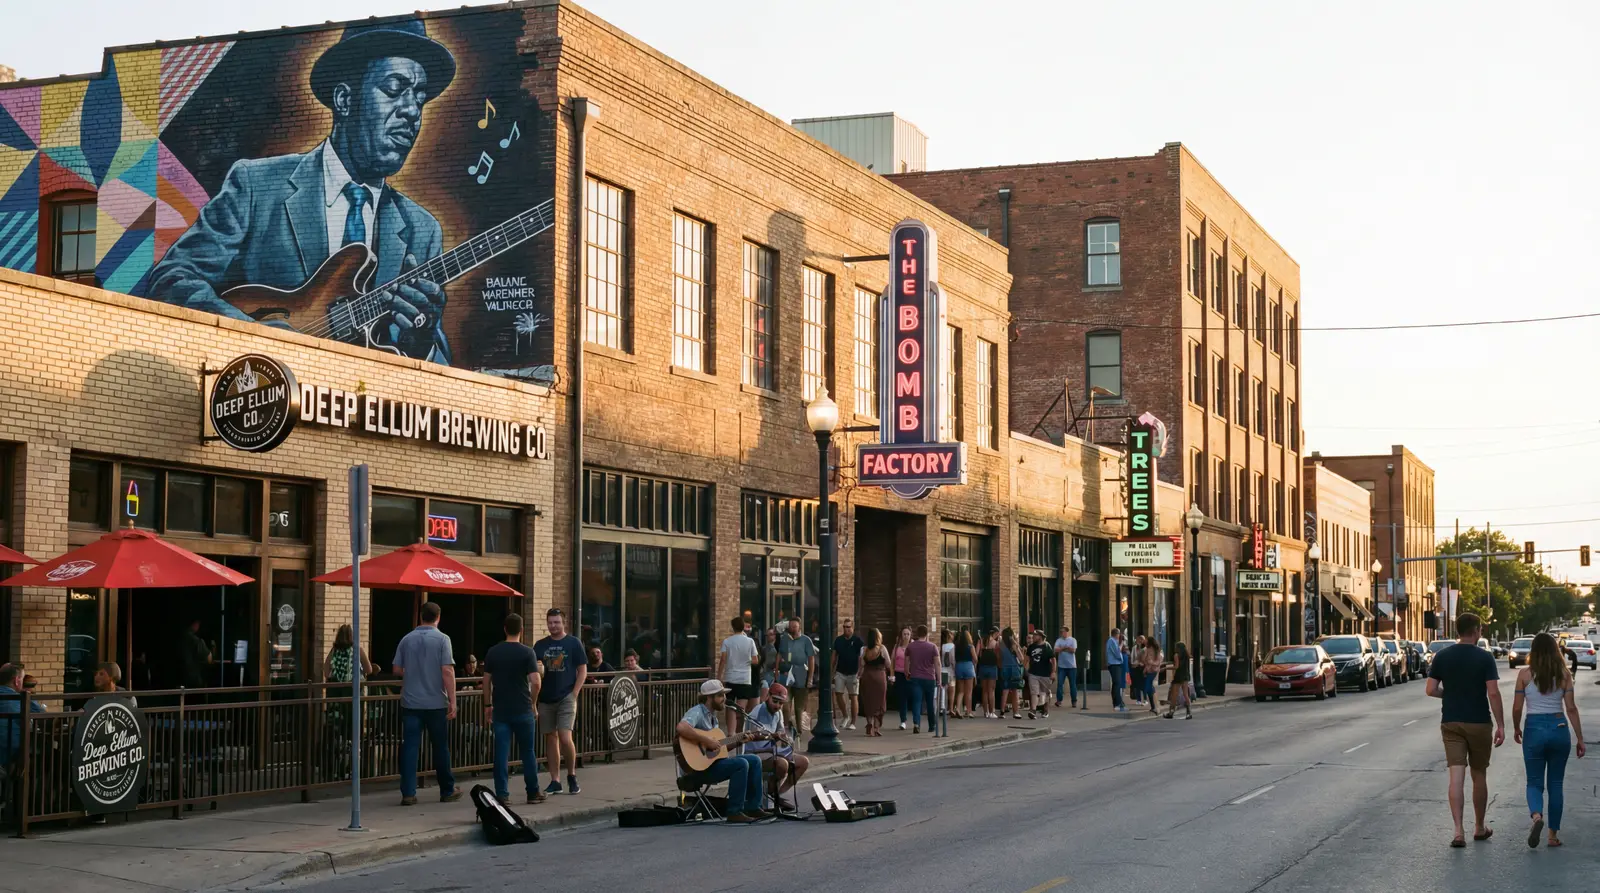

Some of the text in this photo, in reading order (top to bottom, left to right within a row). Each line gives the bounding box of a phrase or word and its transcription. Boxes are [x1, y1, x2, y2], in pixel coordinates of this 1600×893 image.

[897, 239, 920, 431] THE BOMB
[216, 384, 285, 419] DEEP ELLUM
[300, 384, 550, 460] DEEP ELLUM BREWING CO.
[863, 452, 953, 475] FACTORY
[1131, 432, 1148, 531] TREES
[428, 518, 455, 538] OPEN
[110, 729, 138, 752] Ellum
[78, 746, 145, 781] BREWING CO.
